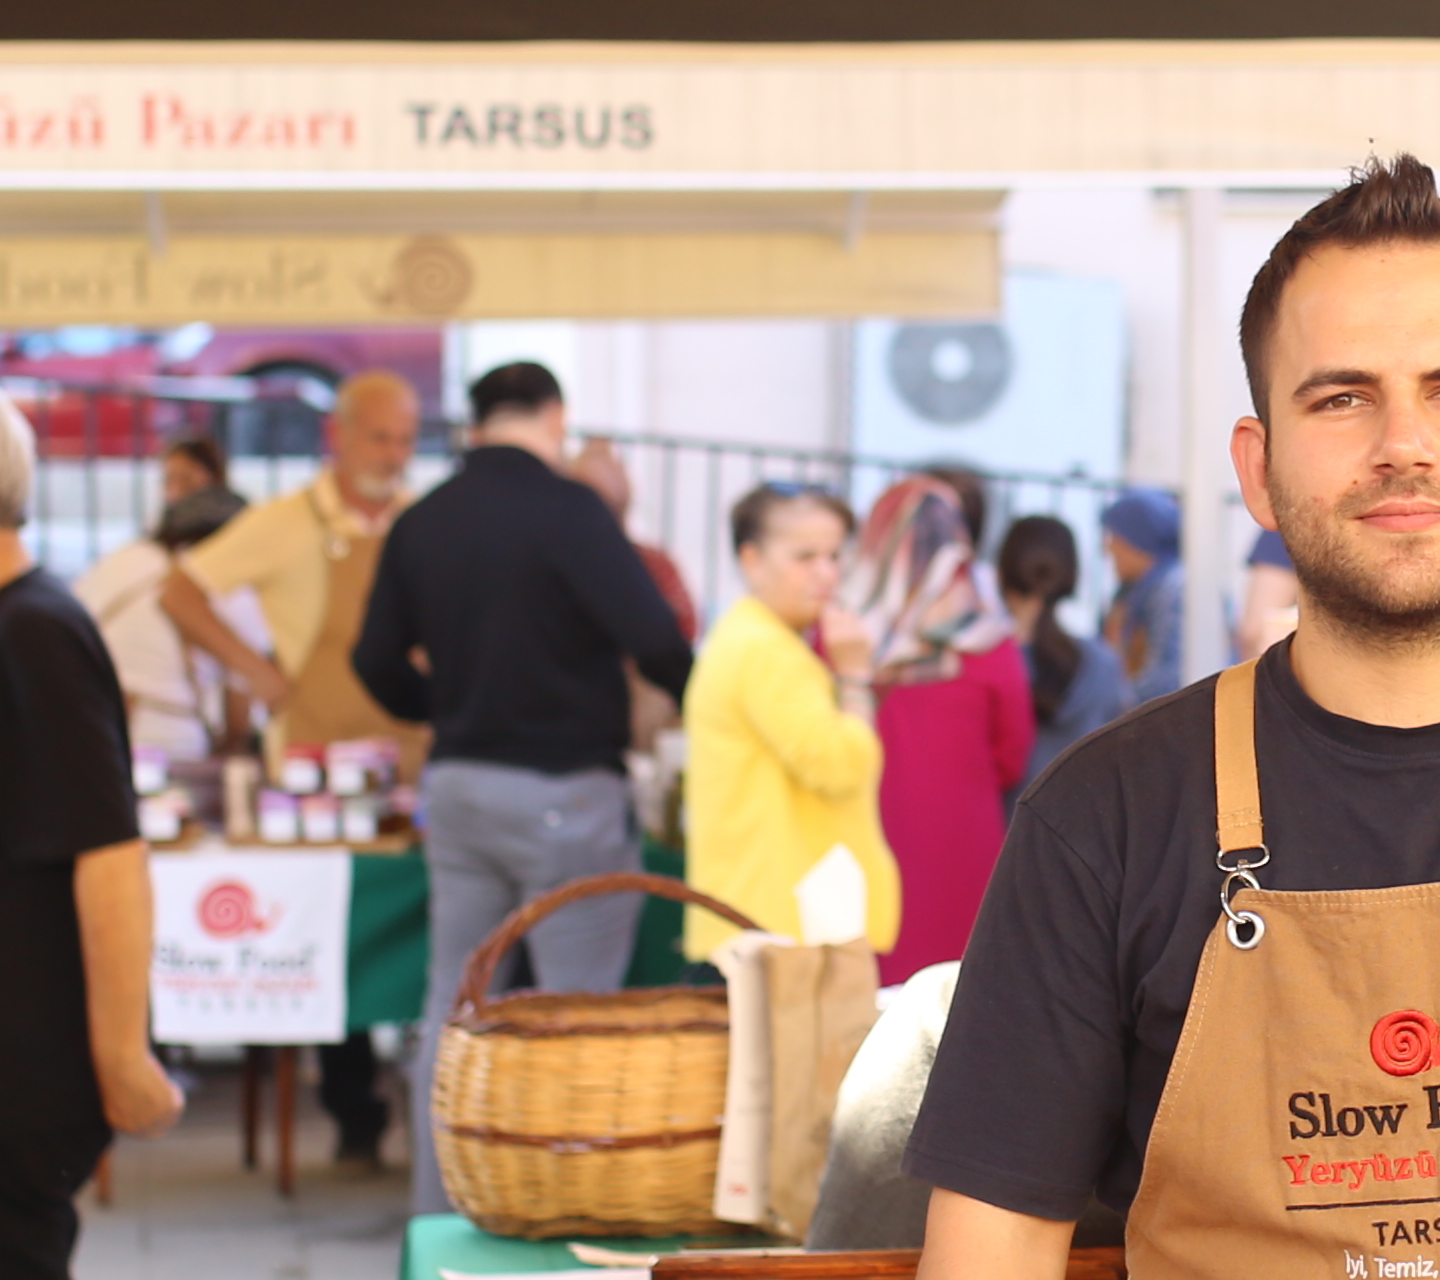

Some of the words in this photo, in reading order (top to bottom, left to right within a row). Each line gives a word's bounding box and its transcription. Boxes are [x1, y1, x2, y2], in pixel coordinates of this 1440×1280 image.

[406, 99, 656, 151] TARSUS
[1289, 1091, 1408, 1140] Slow
[1282, 1150, 1438, 1190] Yeryüzü
[1374, 1256, 1440, 1279] Temiz,
